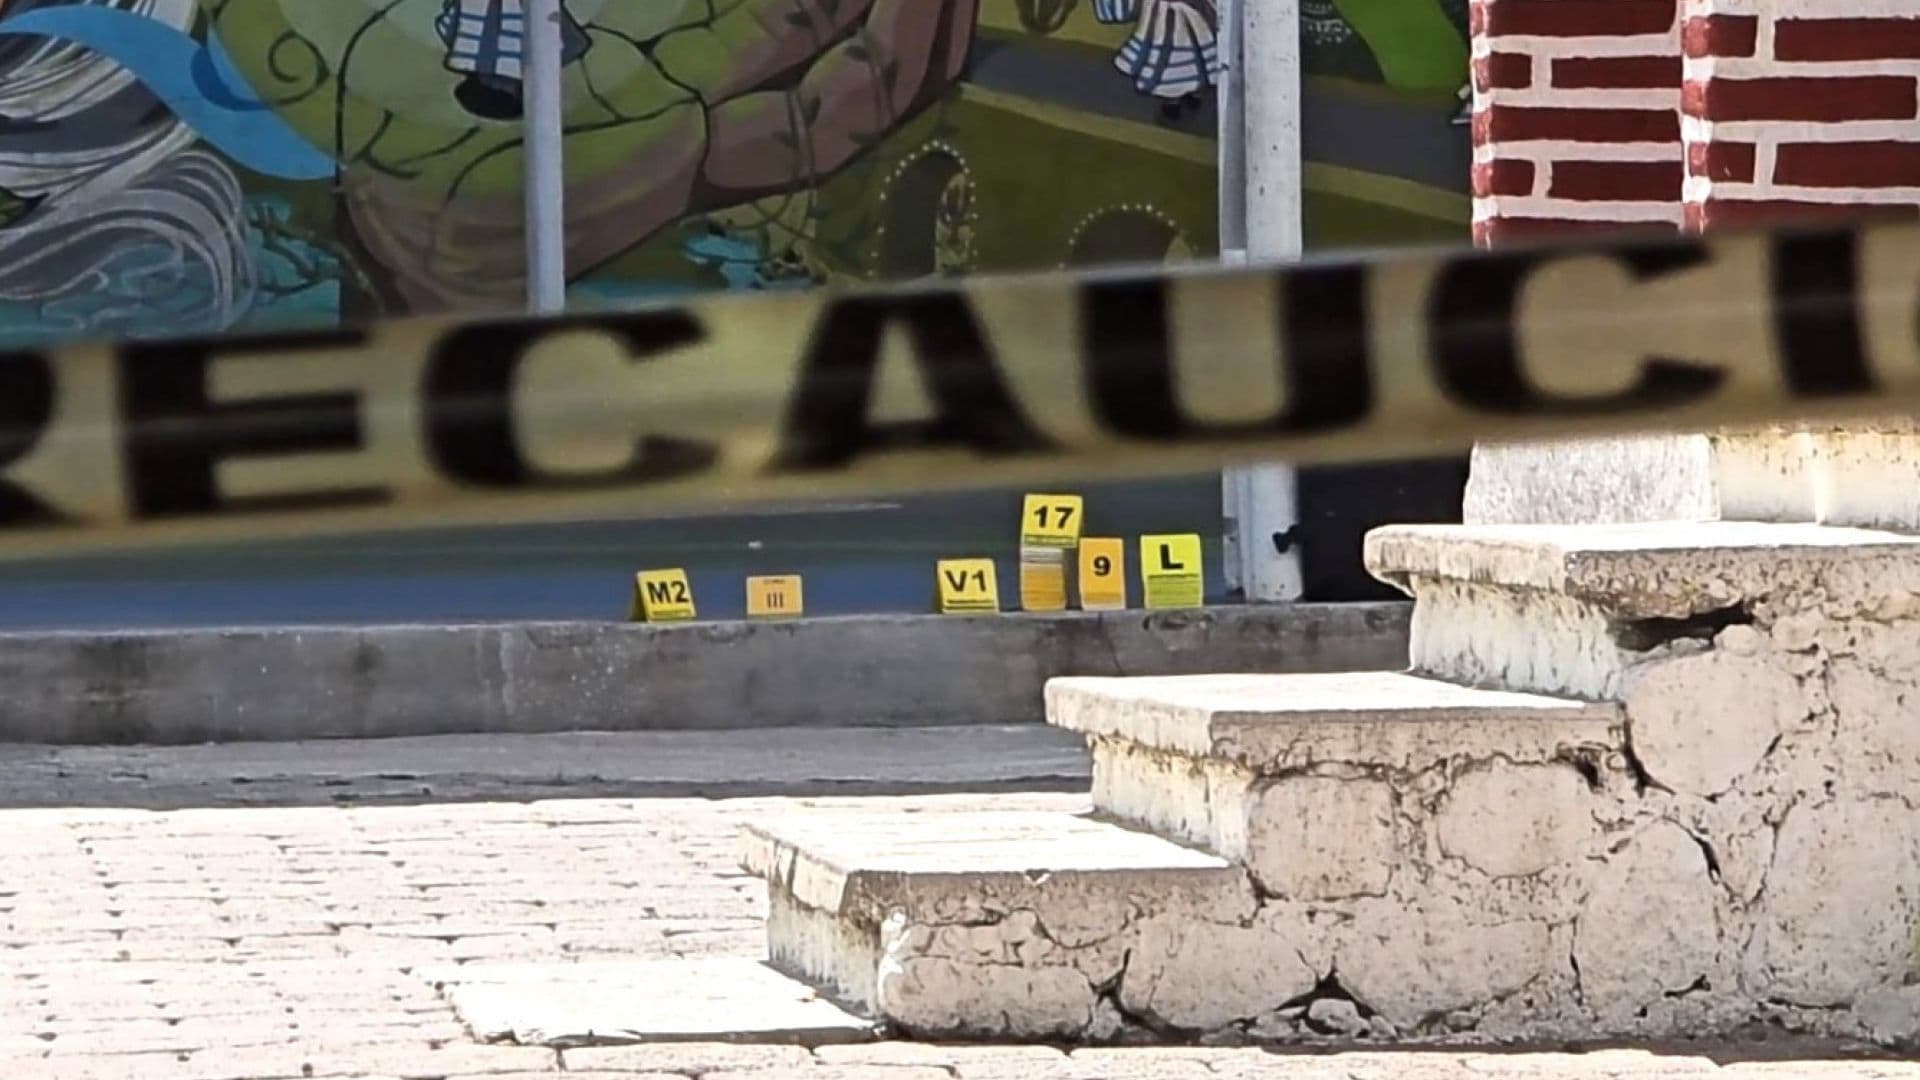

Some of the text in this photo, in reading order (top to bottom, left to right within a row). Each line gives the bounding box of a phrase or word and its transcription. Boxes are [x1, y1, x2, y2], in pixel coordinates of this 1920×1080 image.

[0, 230, 1920, 528] ECAUCI
[1034, 505, 1075, 529] 17
[1093, 556, 1112, 577] 9
[1160, 544, 1184, 570] L
[647, 580, 690, 604] M2
[944, 569, 987, 592] V1
